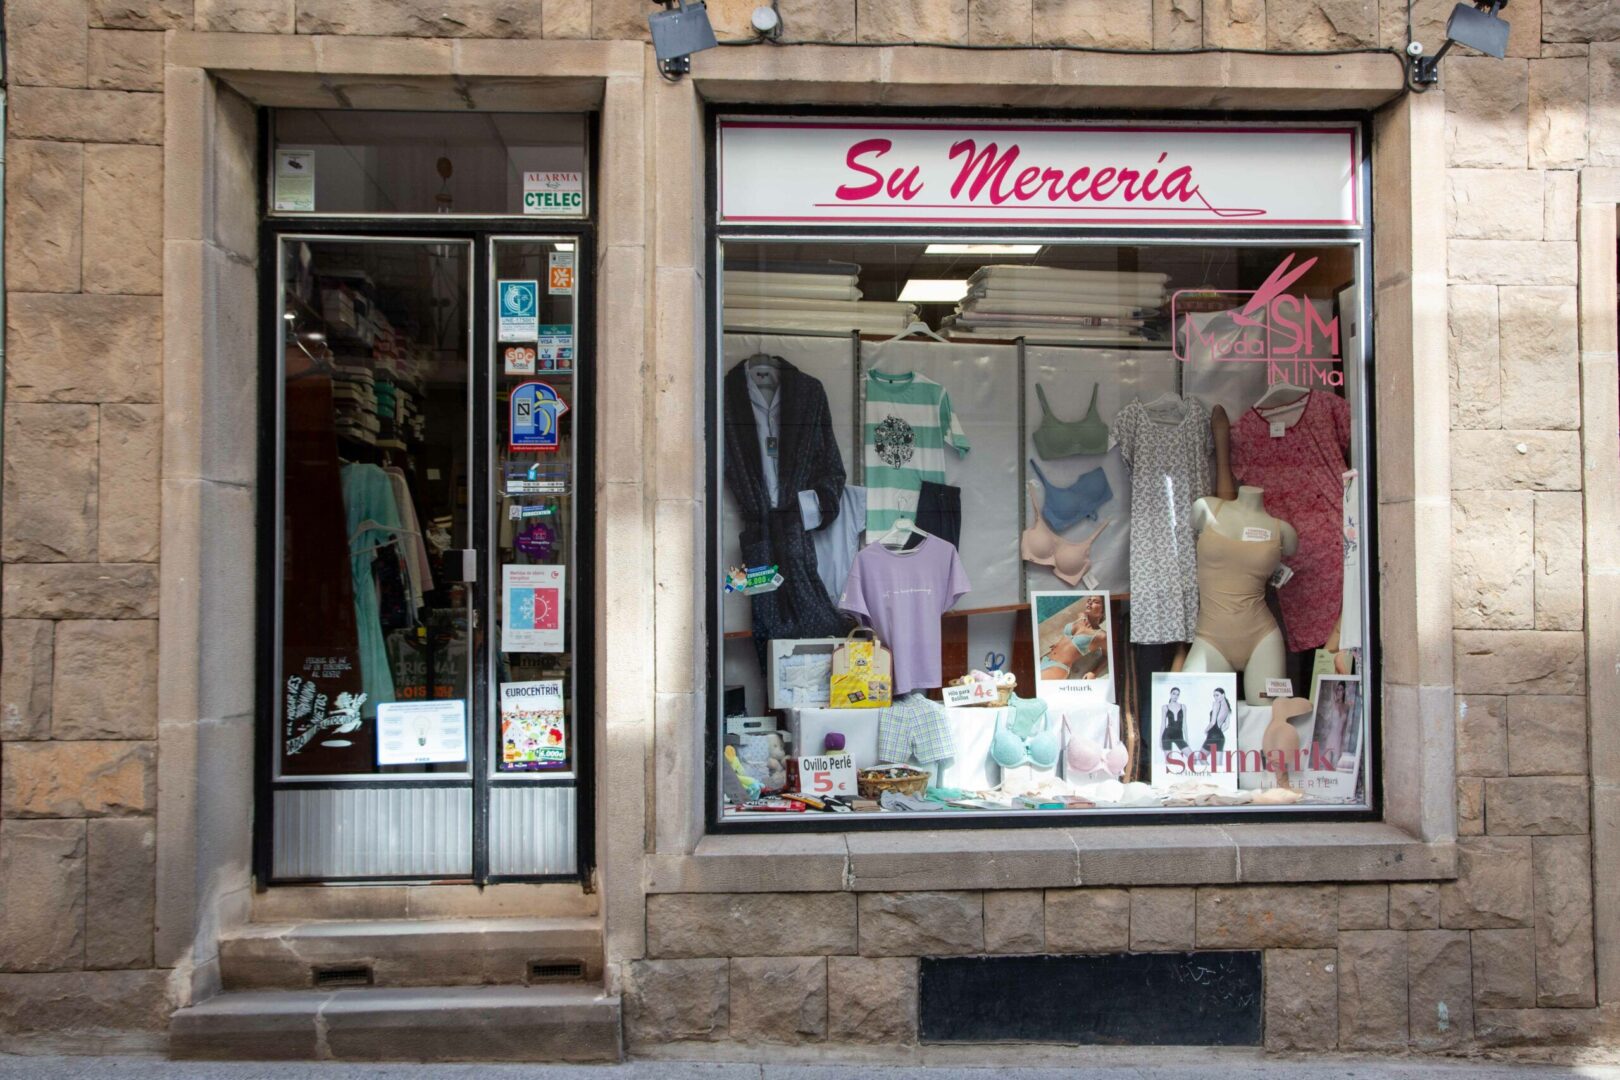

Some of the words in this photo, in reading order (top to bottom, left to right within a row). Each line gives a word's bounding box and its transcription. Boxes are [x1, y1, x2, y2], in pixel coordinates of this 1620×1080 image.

[528, 173, 578, 182] ALARMA
[835, 140, 923, 202] Su
[948, 140, 1199, 208] Mercería
[525, 192, 581, 207] CTELEC
[1271, 293, 1340, 356] SM
[1186, 312, 1265, 361] Moda
[507, 351, 534, 361] SDC
[974, 684, 984, 698] 4
[803, 757, 828, 772] Ovillo
[829, 754, 852, 769] Perlé
[1166, 742, 1336, 774] selmark
[813, 772, 833, 793] 5
[838, 782, 846, 791] €
